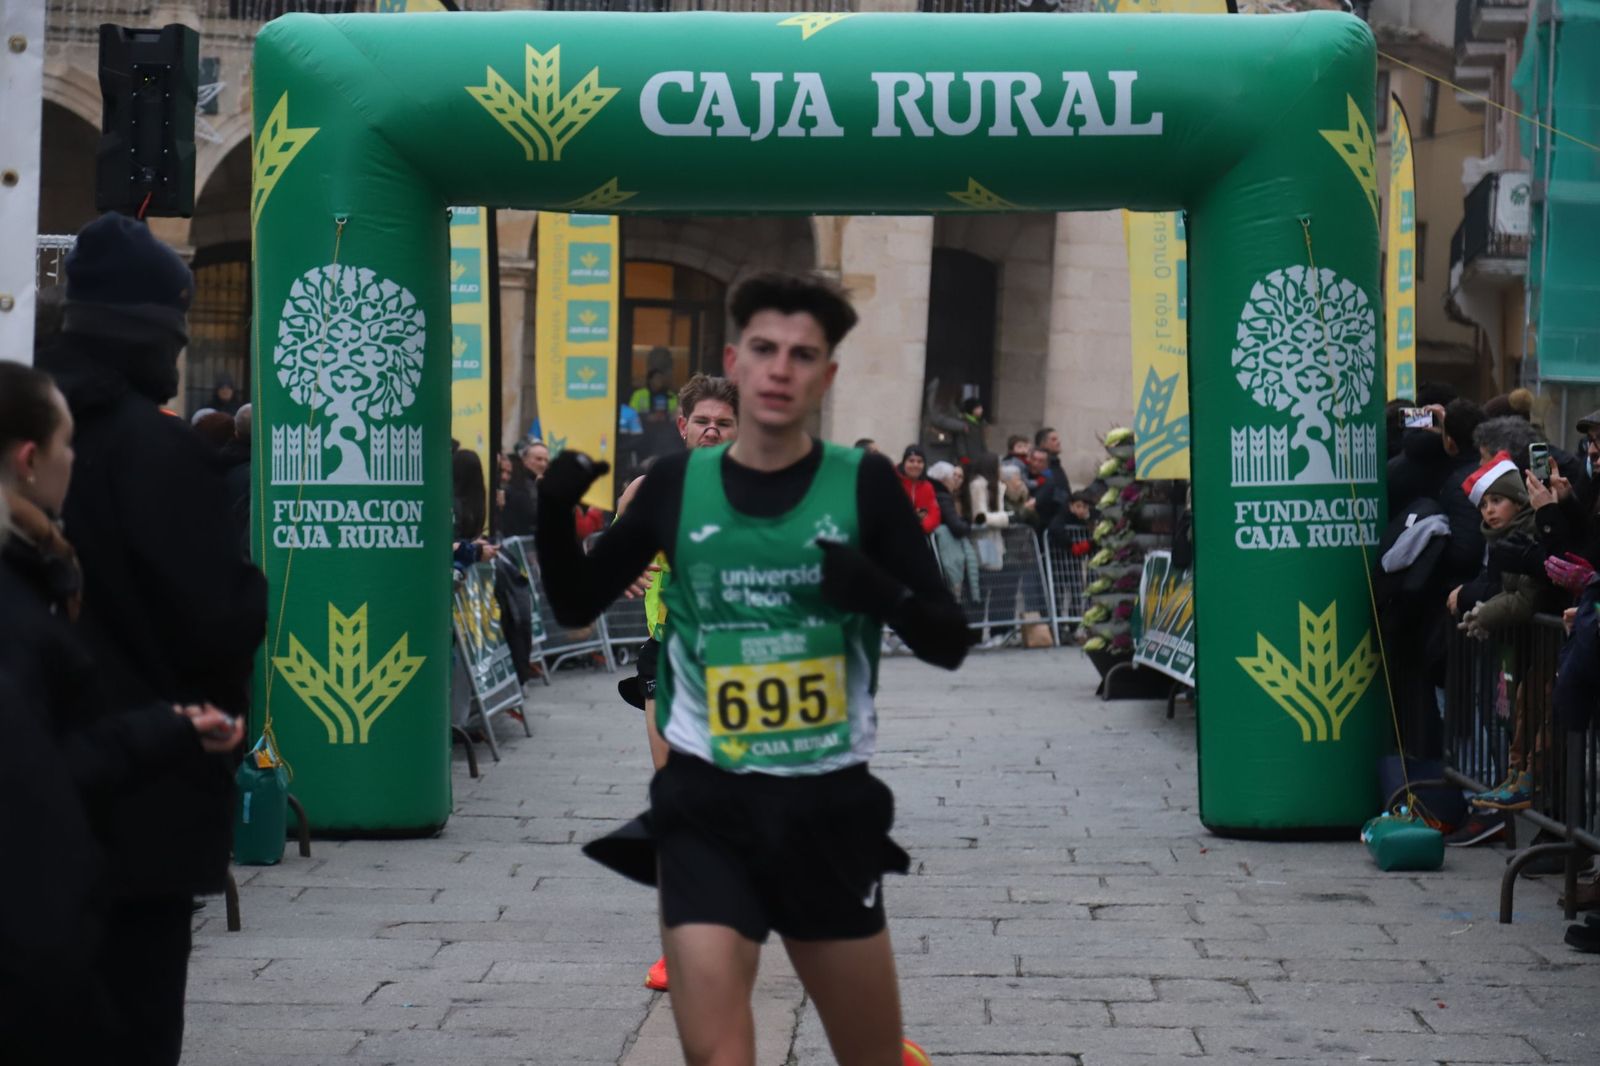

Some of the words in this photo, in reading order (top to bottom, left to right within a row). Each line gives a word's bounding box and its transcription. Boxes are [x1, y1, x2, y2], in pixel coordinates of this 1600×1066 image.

[639, 70, 844, 140] CAJA
[871, 70, 1163, 137] RURAL
[273, 499, 424, 522] FUNDACION
[1234, 498, 1379, 524] FUNDACION
[273, 525, 331, 550] CAJA
[337, 525, 424, 548] RURAL
[1235, 525, 1301, 551] CAJA
[1307, 523, 1380, 547] RURAL
[721, 564, 823, 586] universid
[717, 673, 828, 732] 695
[752, 740, 790, 756] CAJA
[793, 732, 842, 752] RURAL
